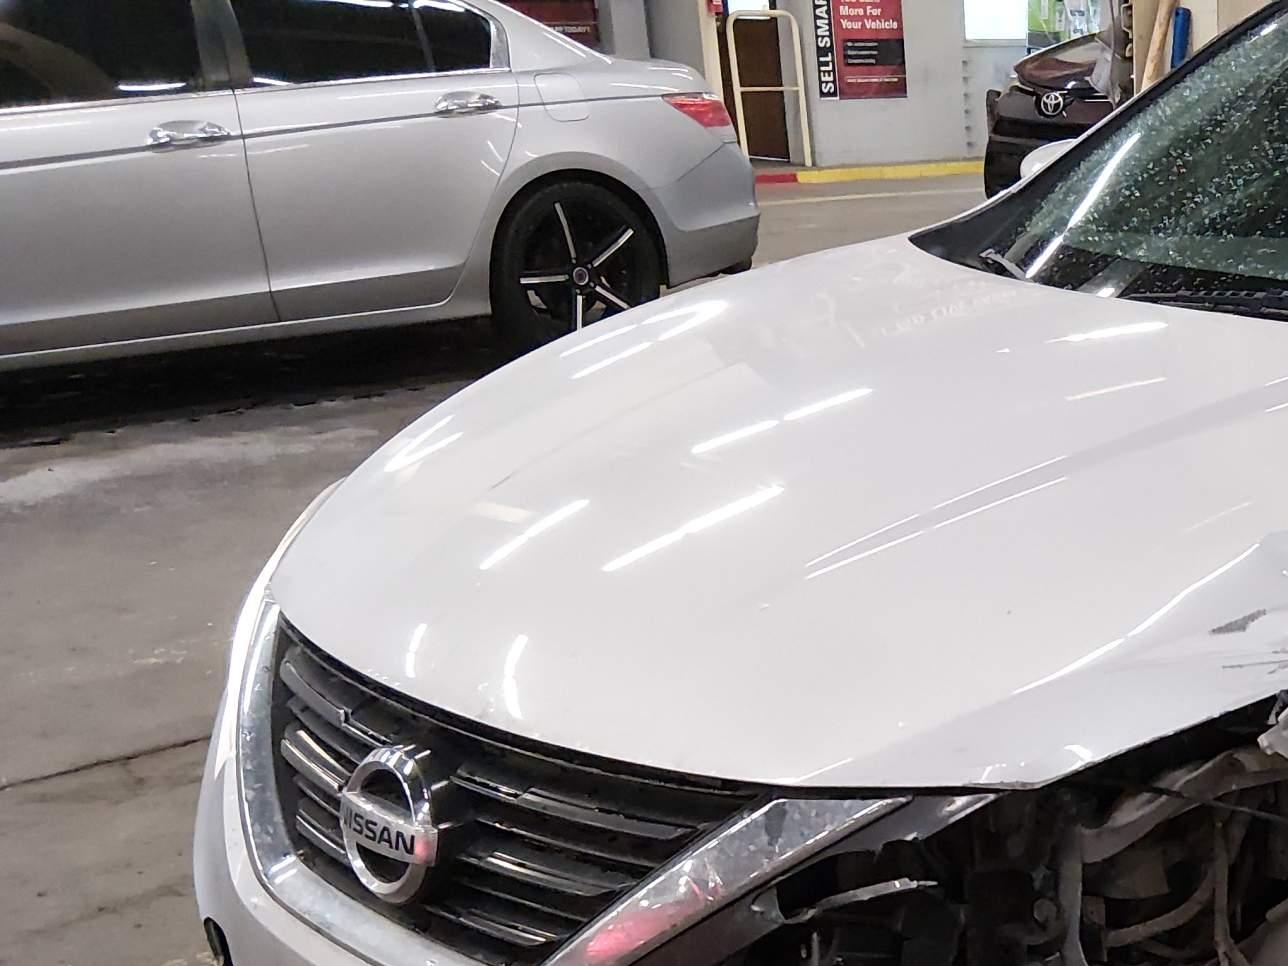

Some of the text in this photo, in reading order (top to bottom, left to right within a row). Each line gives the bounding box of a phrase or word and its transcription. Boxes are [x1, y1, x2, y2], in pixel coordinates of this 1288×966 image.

[840, 5, 882, 16] More For
[840, 19, 898, 29] Your Vehicle
[819, 52, 834, 94] SELL
[343, 806, 415, 855] NISSAN
